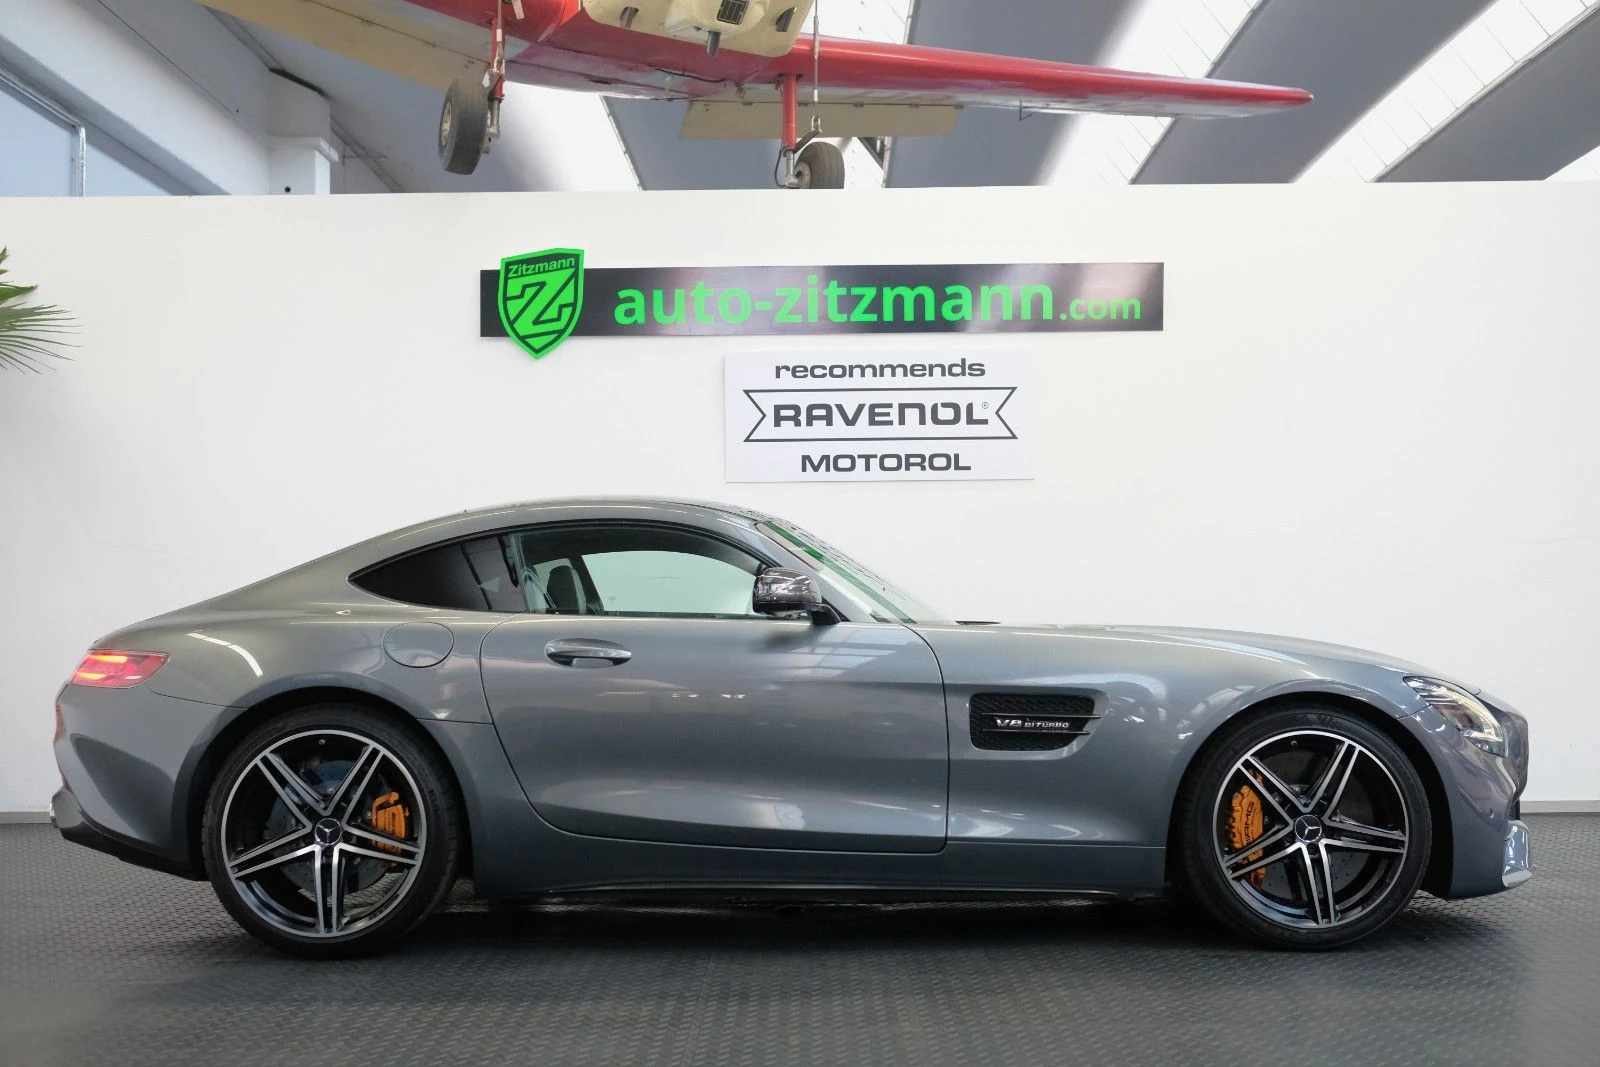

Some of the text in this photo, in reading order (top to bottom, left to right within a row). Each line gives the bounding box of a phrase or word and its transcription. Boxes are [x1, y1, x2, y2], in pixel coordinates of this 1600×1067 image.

[508, 257, 575, 278] Zitzmann
[775, 358, 986, 379] recommends
[801, 452, 972, 473] MOTOROL
[995, 718, 1022, 727] V8
